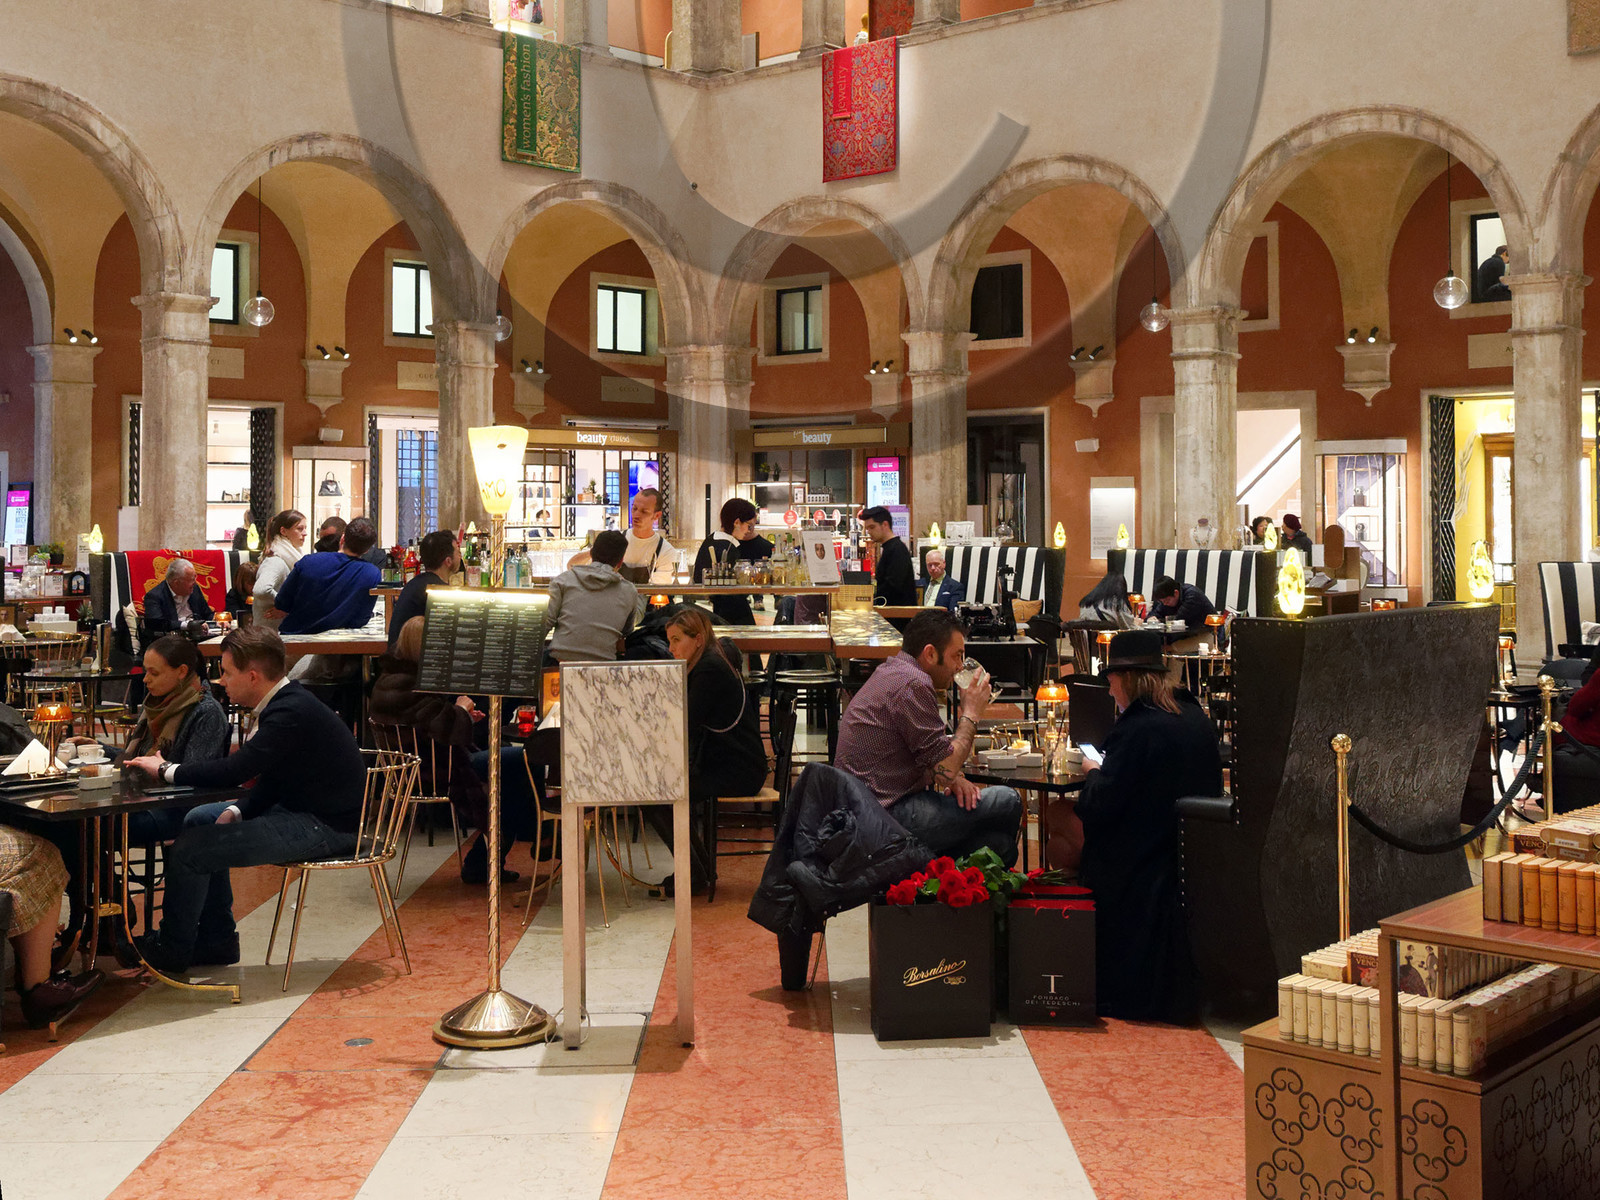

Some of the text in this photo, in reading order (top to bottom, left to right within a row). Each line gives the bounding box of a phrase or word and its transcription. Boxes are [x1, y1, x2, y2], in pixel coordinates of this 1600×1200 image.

[520, 43, 532, 149] women's fashion
[836, 66, 848, 113] jewelry
[577, 432, 608, 446] beauty
[802, 432, 832, 445] beauty
[881, 472, 897, 480] PRICE
[903, 958, 966, 987] Borsalino
[1041, 974, 1064, 994] T
